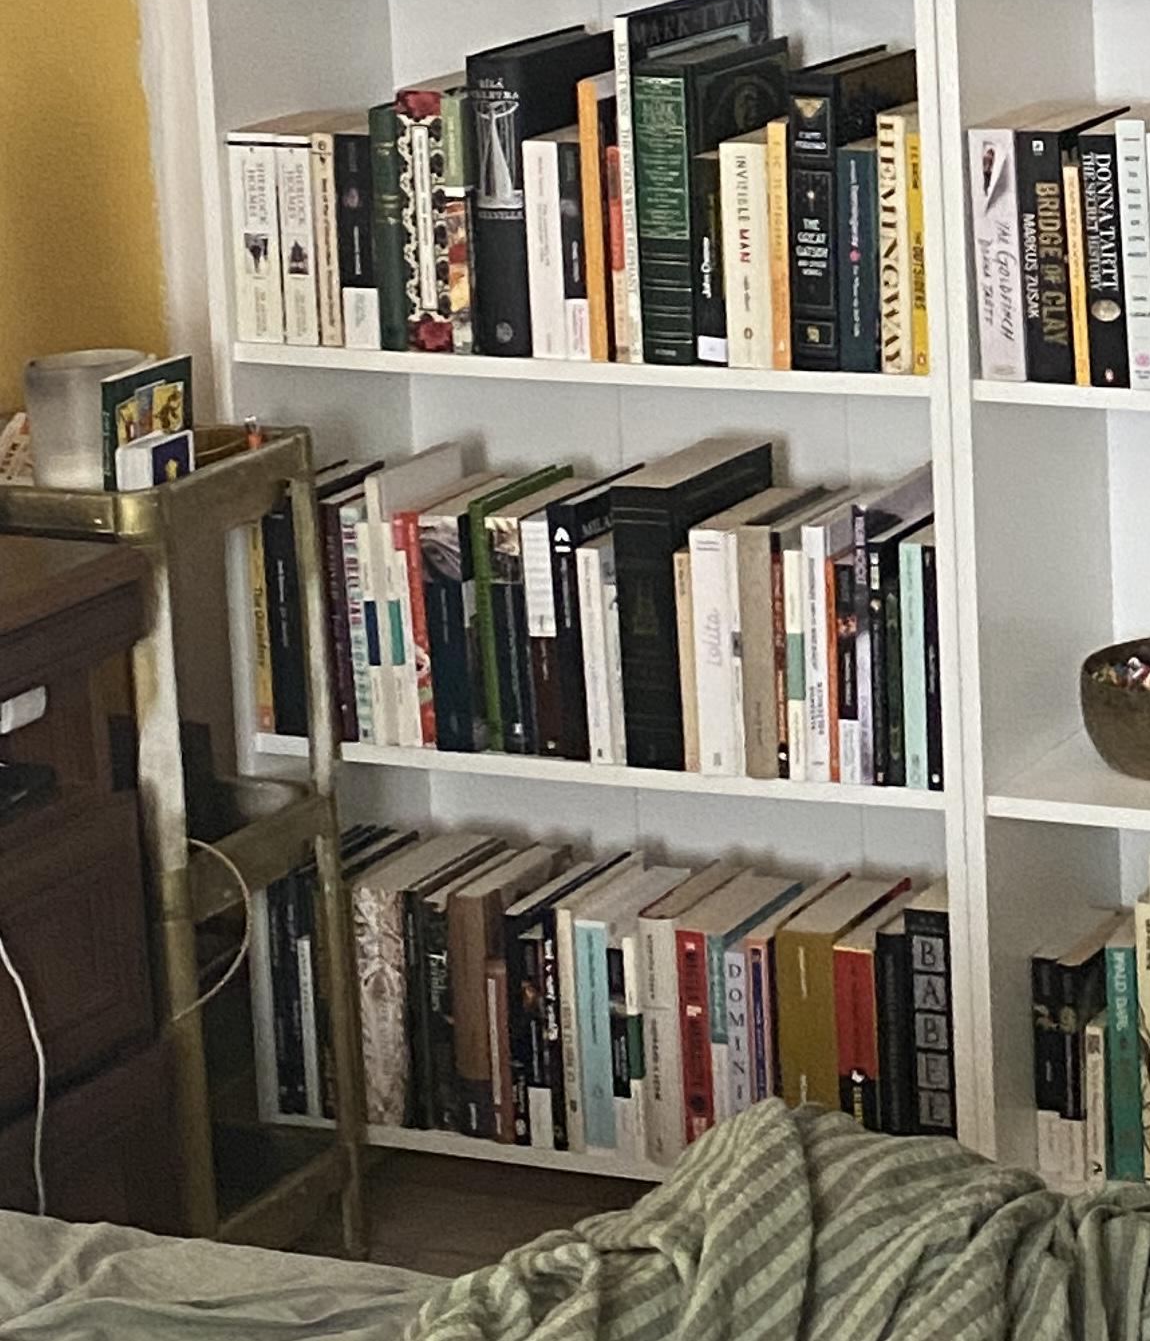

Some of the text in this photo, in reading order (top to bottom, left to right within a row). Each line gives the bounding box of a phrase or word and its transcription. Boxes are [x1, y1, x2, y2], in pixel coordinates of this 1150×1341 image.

[734, 155, 751, 263] INVISIBLE MAN
[879, 122, 901, 366] HEMINGWAY
[1023, 213, 1040, 319] MARKUS ZUSAK
[1035, 182, 1068, 346] BRIDGE OF CLAY
[1096, 153, 1119, 292] DONNA TARTT
